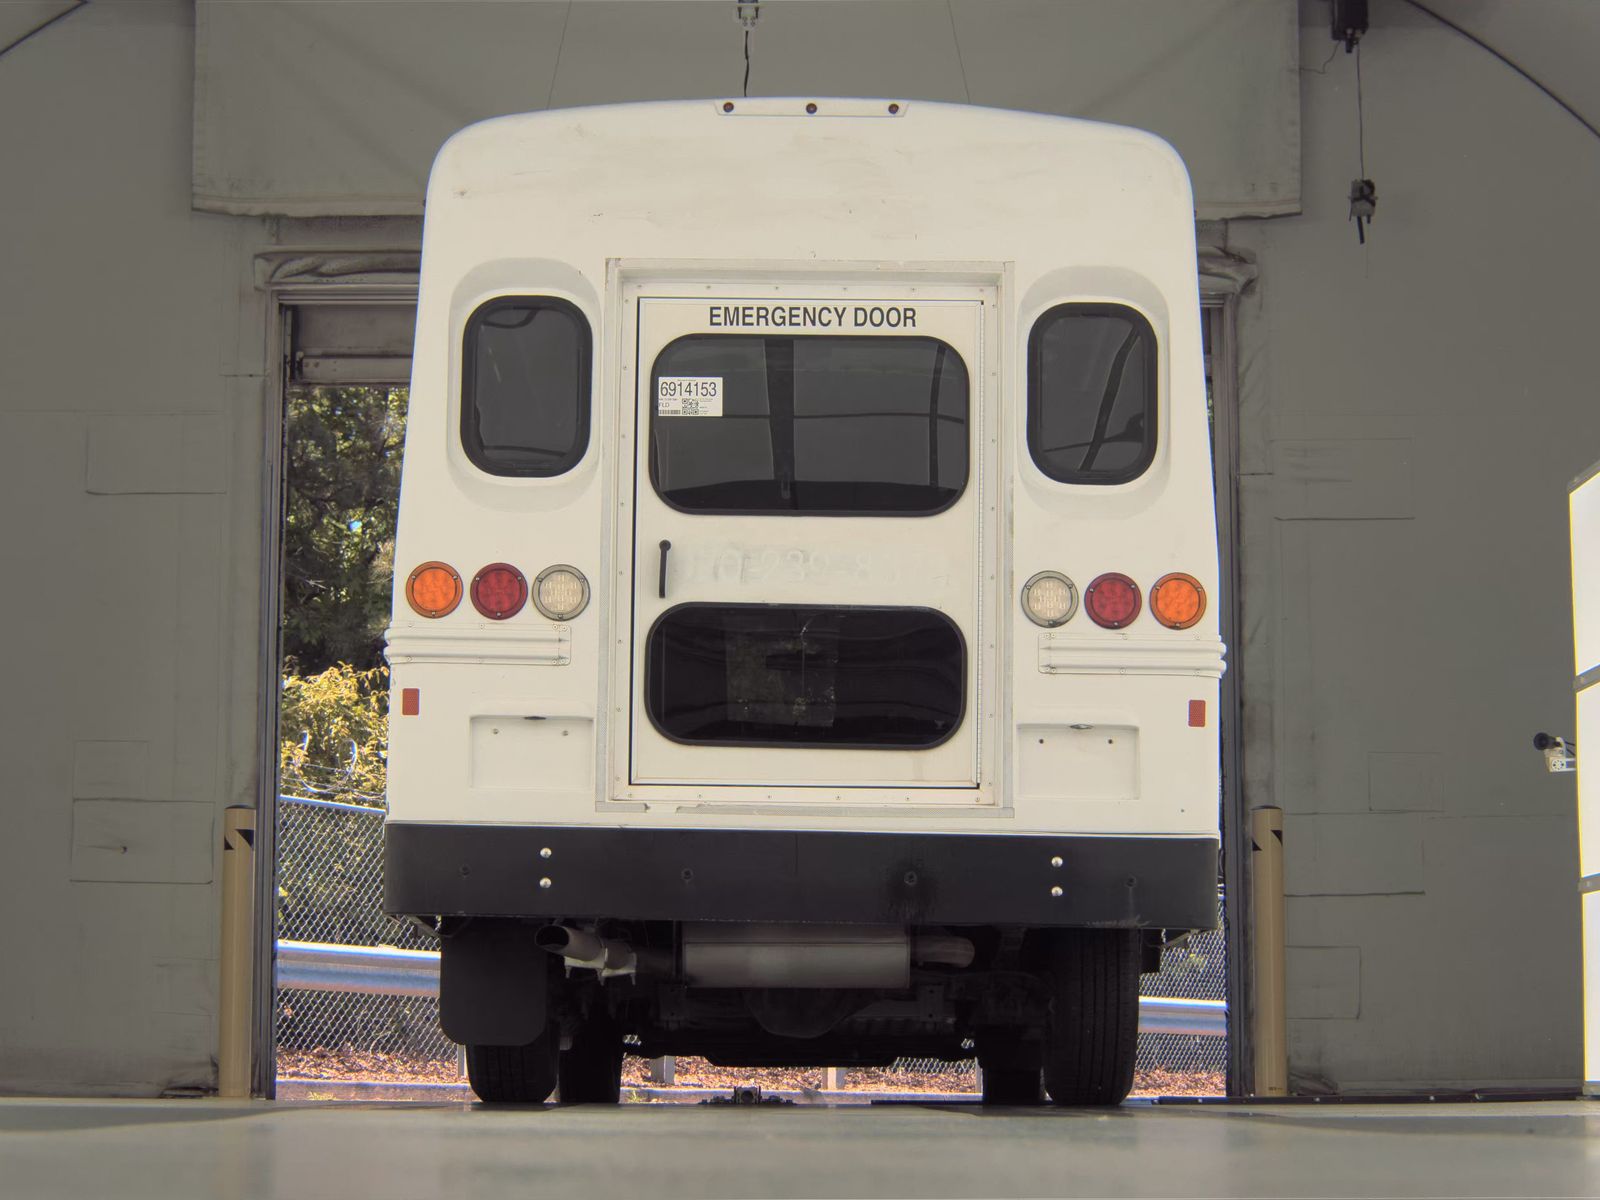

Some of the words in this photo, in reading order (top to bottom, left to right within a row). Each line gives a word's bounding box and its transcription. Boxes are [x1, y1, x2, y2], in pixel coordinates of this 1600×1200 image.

[709, 306, 847, 327] EMERGENCY
[854, 307, 917, 328] DOOR
[660, 381, 717, 397] 6914153
